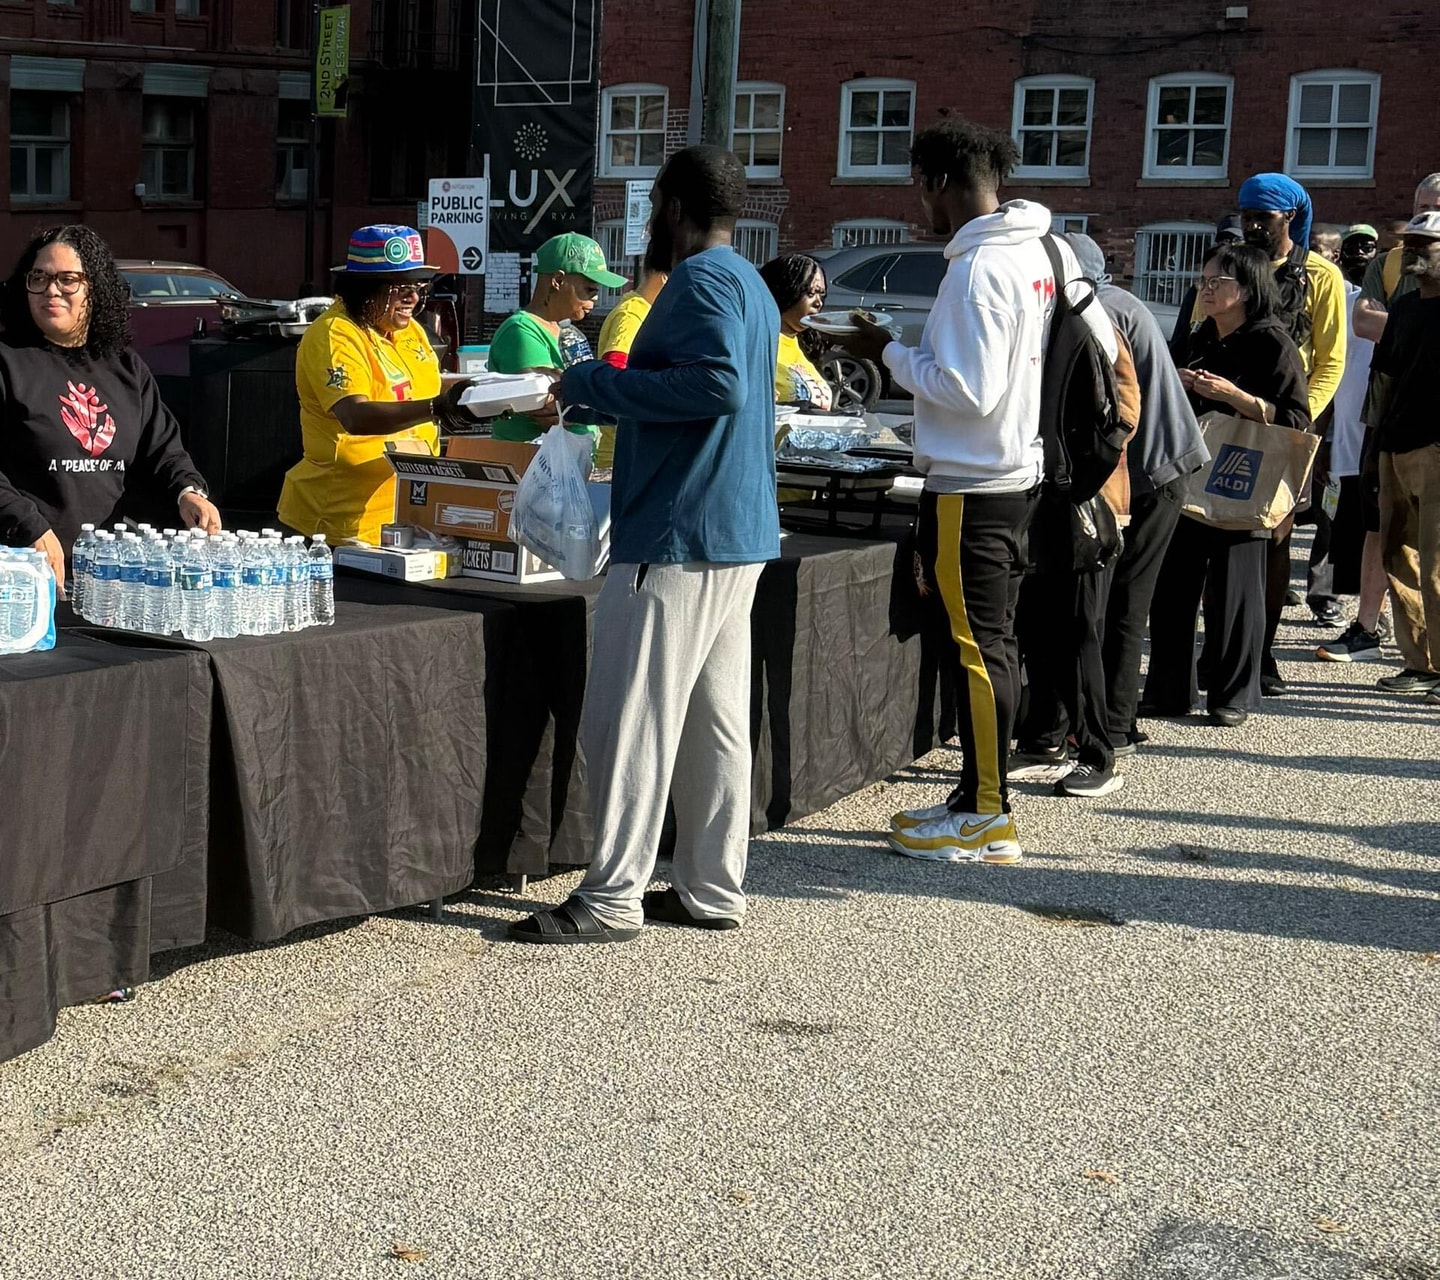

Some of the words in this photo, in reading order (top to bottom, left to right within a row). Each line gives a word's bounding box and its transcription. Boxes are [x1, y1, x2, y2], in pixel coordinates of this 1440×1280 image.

[320, 13, 333, 66] STREET
[335, 13, 347, 77] FESTIVAL
[320, 70, 331, 99] 2ND
[432, 195, 483, 211] PUBLIC
[430, 211, 483, 224] PARKING
[551, 211, 576, 221] RVA
[48, 458, 58, 472] A
[61, 458, 100, 473] "PEACE"
[100, 458, 114, 472] OF
[1212, 476, 1251, 493] ALDI
[462, 549, 490, 570] ACKETS
